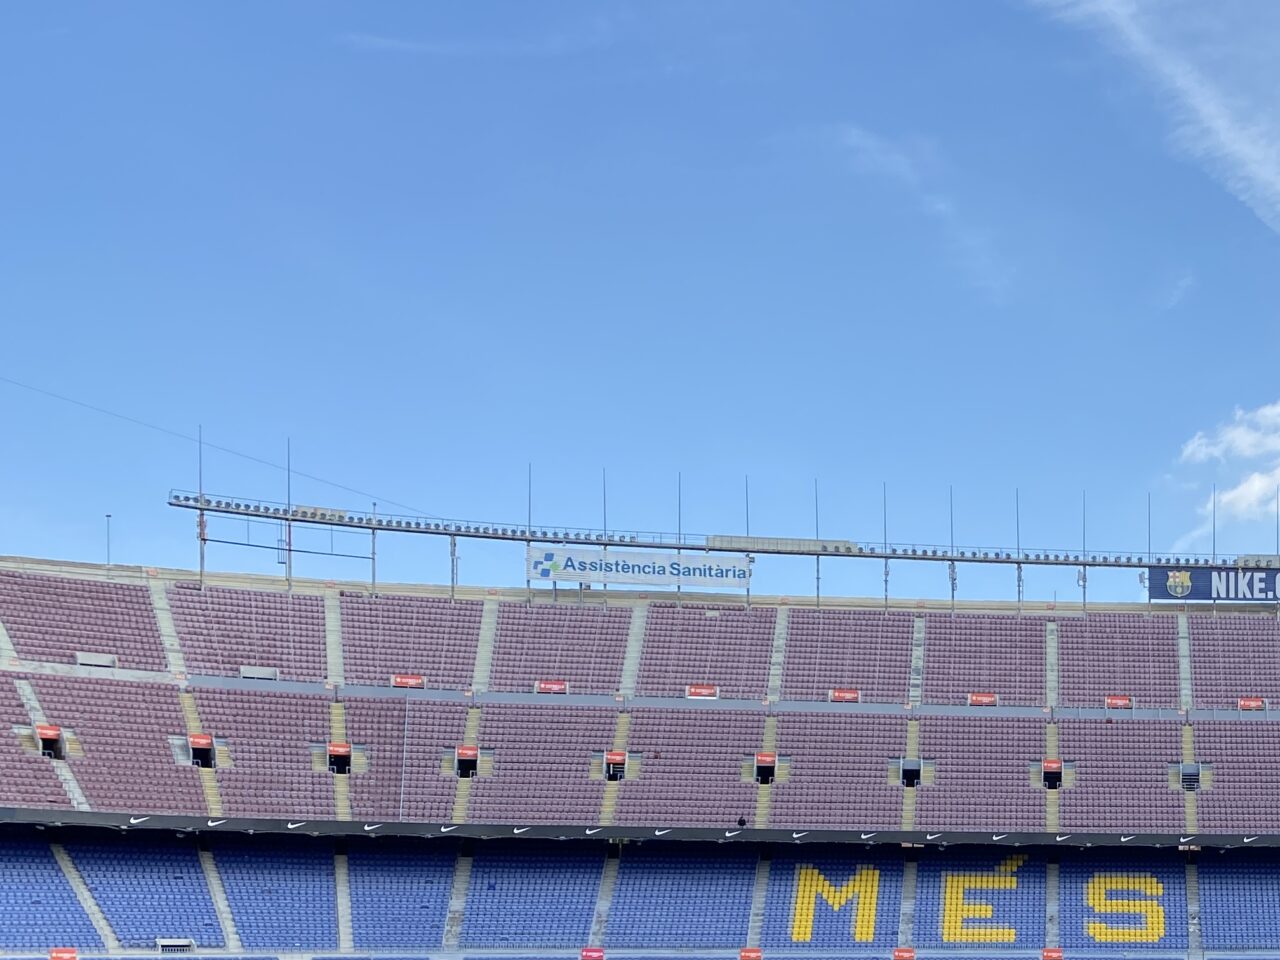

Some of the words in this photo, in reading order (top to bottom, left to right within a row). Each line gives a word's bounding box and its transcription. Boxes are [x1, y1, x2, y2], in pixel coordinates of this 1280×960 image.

[563, 556, 666, 575] Assistència
[669, 561, 746, 579] Sanitària
[790, 854, 1165, 942] MÉS
